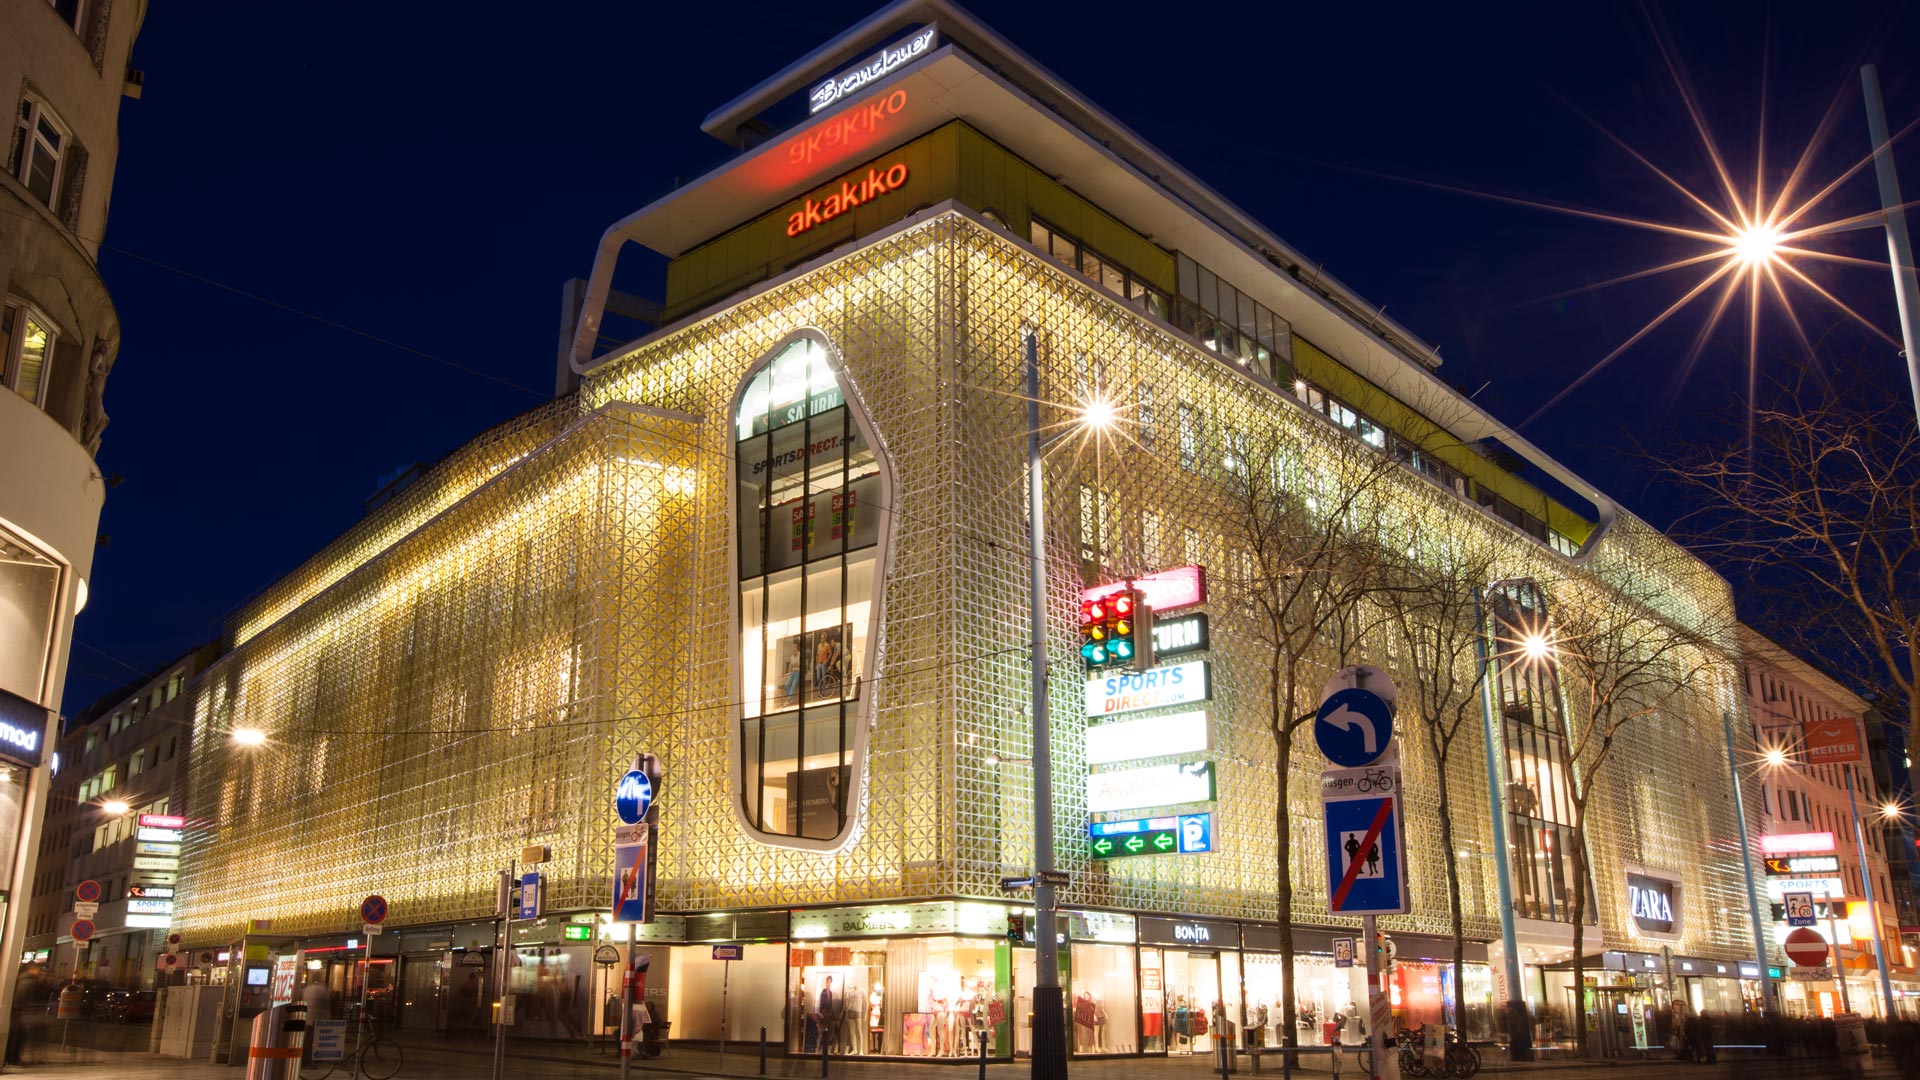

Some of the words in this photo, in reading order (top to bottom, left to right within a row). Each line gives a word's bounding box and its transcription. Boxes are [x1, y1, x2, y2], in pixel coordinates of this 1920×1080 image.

[811, 29, 934, 113] Brandauer
[787, 163, 909, 237] akakiko
[753, 435, 856, 475] SPRTSDRECT.CM
[793, 506, 815, 521] SAE
[832, 494, 855, 510] SAE
[1105, 666, 1184, 696] SPORTS
[1811, 743, 1857, 756] REITER
[1779, 880, 1829, 889] SPORTS
[1629, 886, 1674, 922] ZARA
